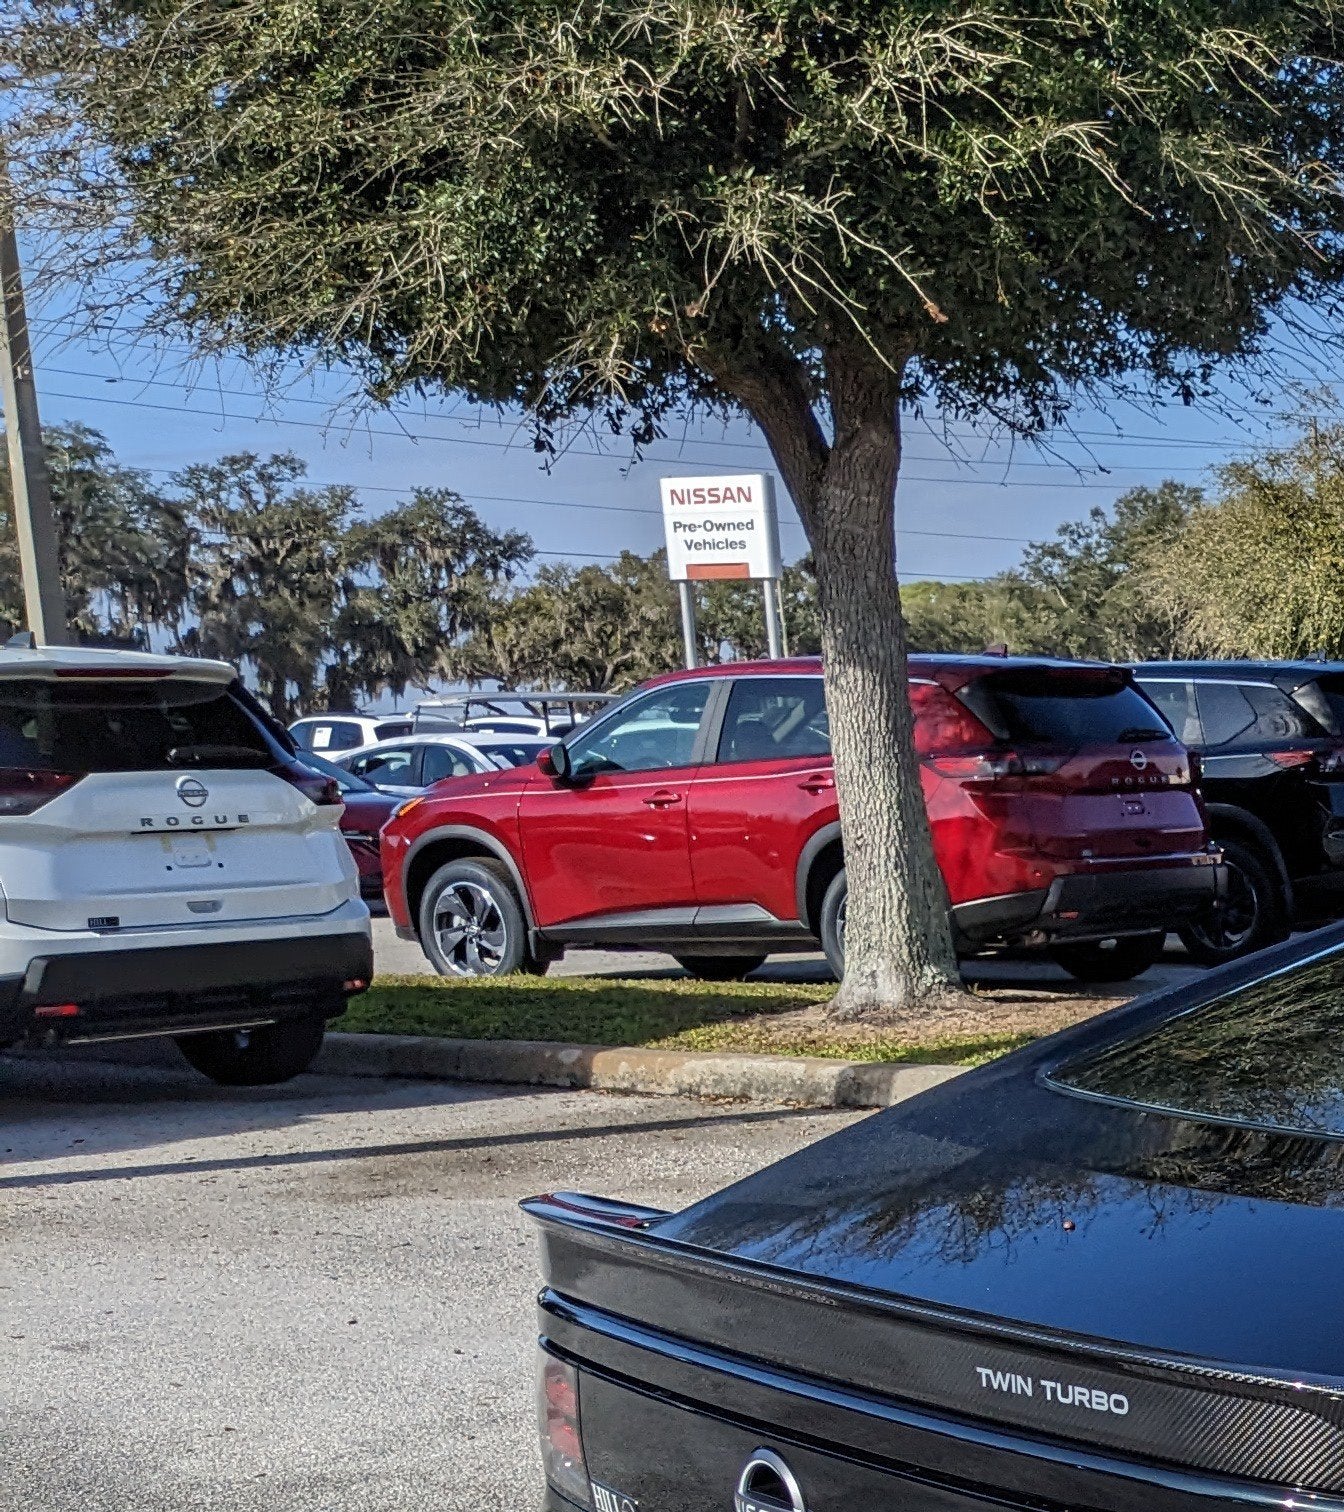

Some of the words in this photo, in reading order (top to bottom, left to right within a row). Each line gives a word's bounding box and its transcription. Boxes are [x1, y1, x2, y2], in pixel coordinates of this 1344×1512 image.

[670, 486, 752, 505] NISSAN
[673, 519, 754, 533] Pre-Owned
[684, 538, 747, 551] Vehicles
[140, 814, 249, 827] ROGUE
[976, 1366, 1033, 1397] TWIN
[1040, 1379, 1129, 1415] TURBO
